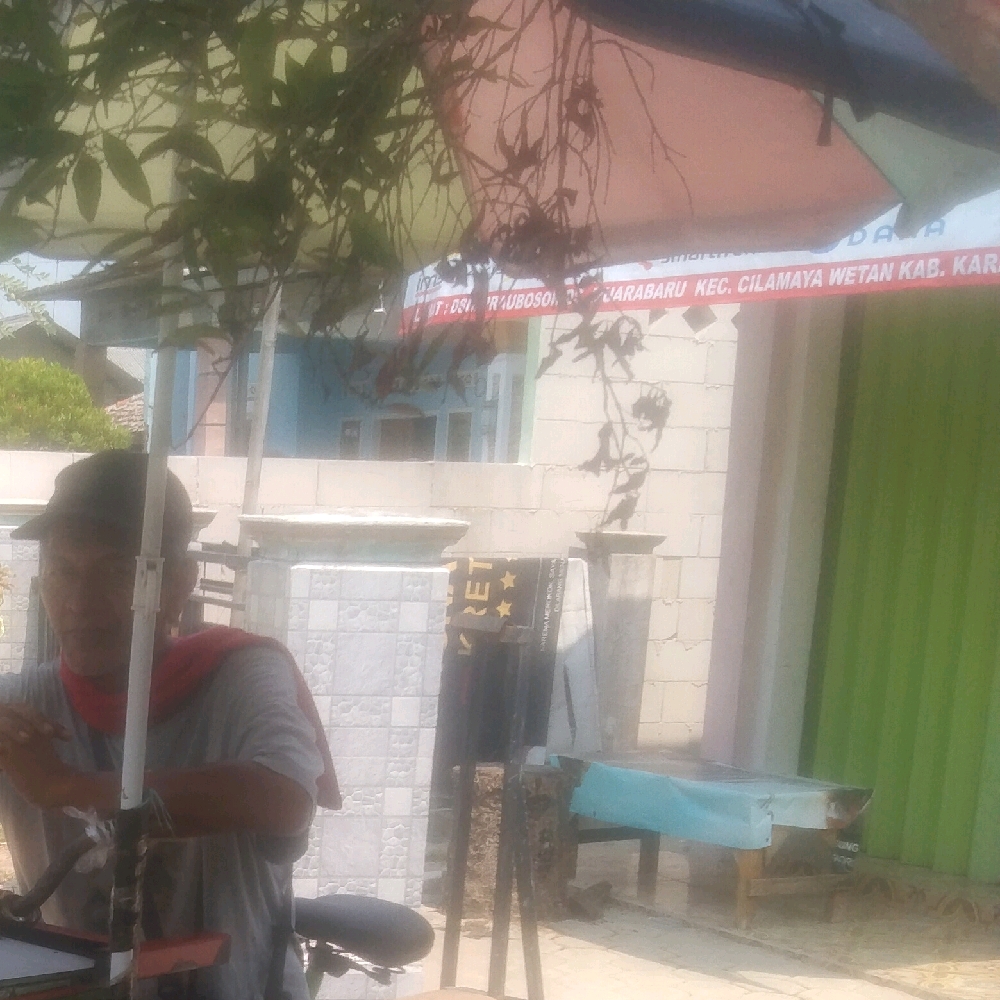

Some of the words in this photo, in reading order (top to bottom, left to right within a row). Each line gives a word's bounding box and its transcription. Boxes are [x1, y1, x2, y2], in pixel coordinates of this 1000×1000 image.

[847, 218, 946, 247] DAA
[695, 277, 731, 297] KEC.
[738, 269, 823, 293] CILAMAYA
[828, 262, 894, 286] WETAN
[898, 257, 945, 280] KAB.
[952, 253, 1000, 276] KAR
